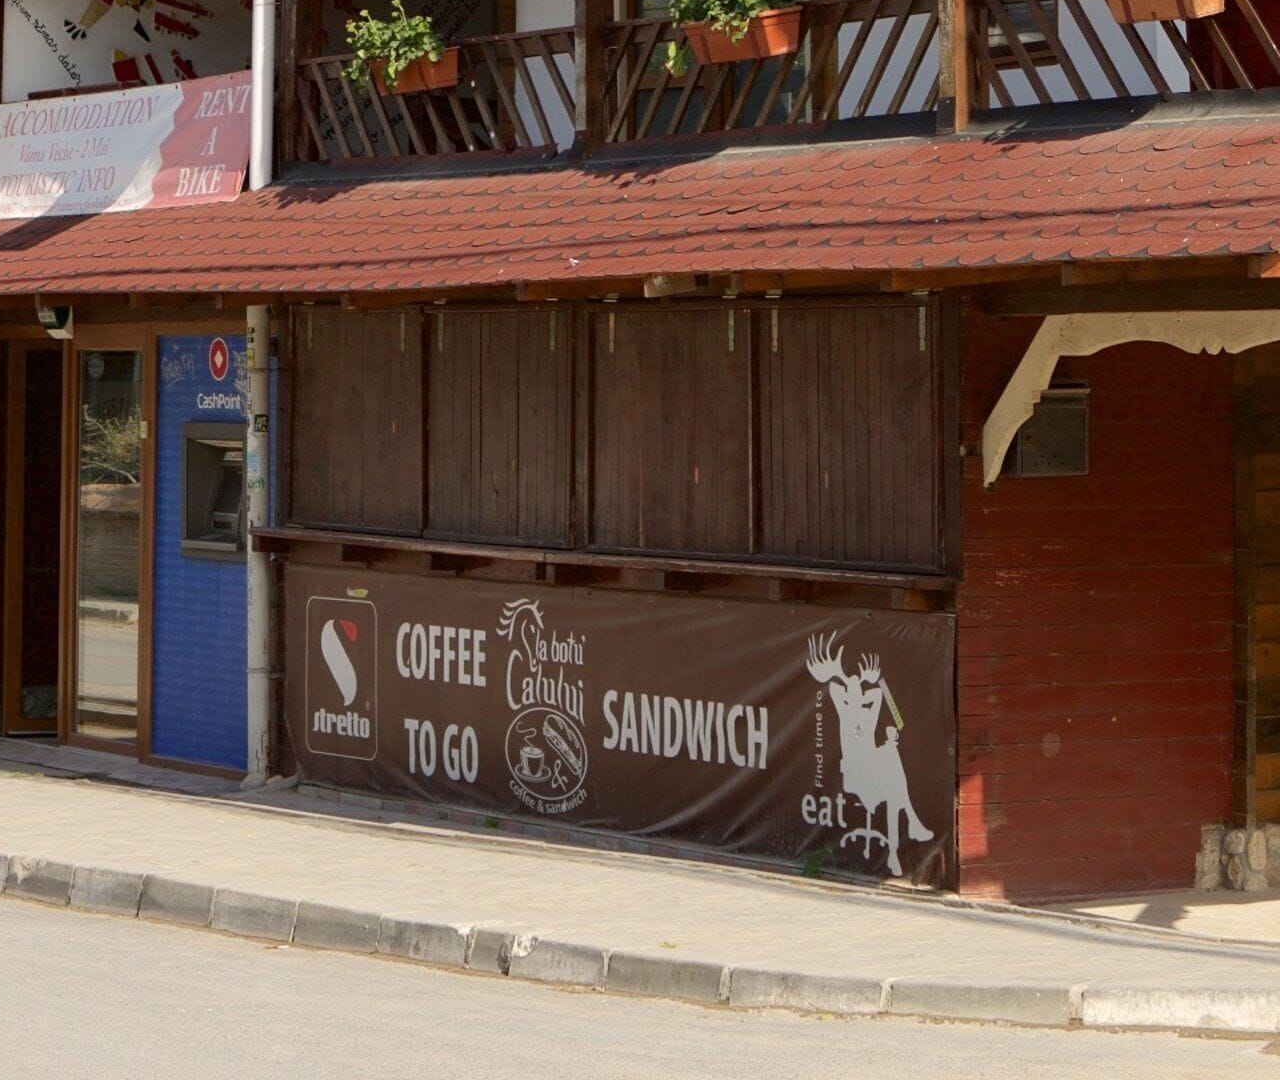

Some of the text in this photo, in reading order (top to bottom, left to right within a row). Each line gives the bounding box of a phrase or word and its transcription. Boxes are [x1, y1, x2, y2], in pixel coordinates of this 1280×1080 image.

[0, 95, 160, 139] ACCOMMODATION
[194, 85, 252, 119] RENT
[19, 144, 45, 164] Vama
[48, 141, 74, 162] Veche
[200, 125, 218, 156] A
[77, 166, 116, 193] INFO
[174, 164, 226, 197] BIKE
[197, 392, 241, 410] CashPoint
[396, 621, 487, 687] COFFEE
[506, 649, 586, 727] Calului
[313, 708, 370, 739] stretto
[602, 689, 768, 771] SANDWICH
[814, 690, 824, 788] Find time to
[404, 718, 479, 783] TO GO
[509, 780, 535, 809] coffee
[545, 788, 588, 814] sandwich
[801, 792, 847, 828] eat
